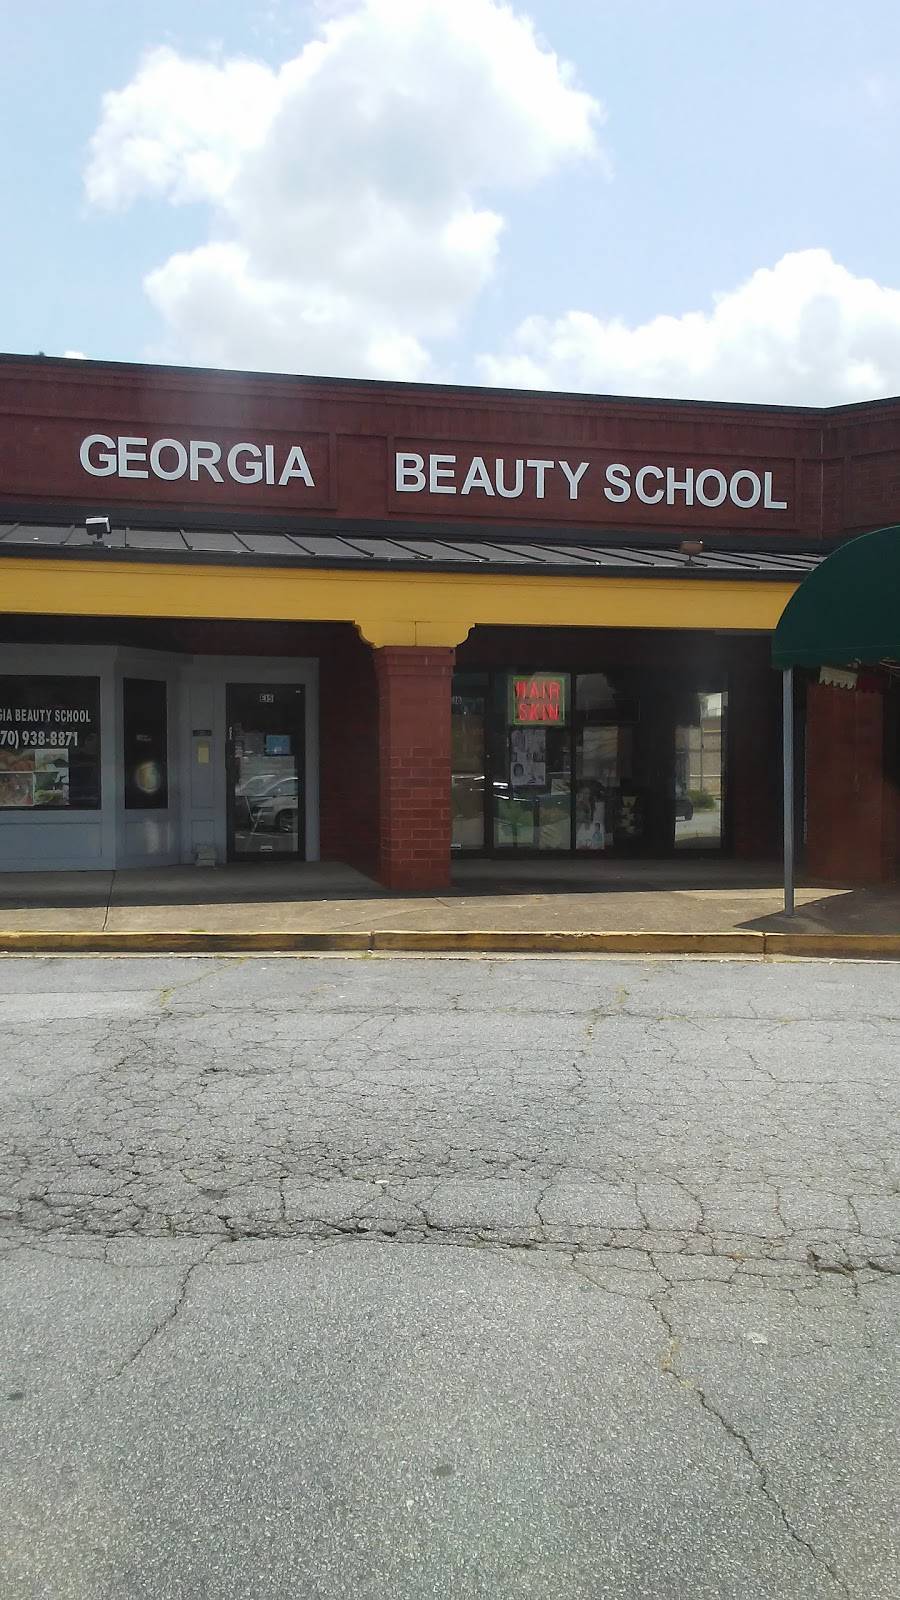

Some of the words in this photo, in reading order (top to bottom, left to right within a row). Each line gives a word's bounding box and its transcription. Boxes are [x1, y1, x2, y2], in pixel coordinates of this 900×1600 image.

[79, 434, 315, 488] GEORGIA
[395, 452, 590, 501] BEAUTY
[603, 463, 789, 511] SCHOOL
[0, 708, 12, 722] IA
[15, 709, 52, 722] BEAUTY
[54, 709, 92, 723] SCHOOL
[519, 703, 559, 721] SKIN
[22, 730, 79, 747] 938-8871
